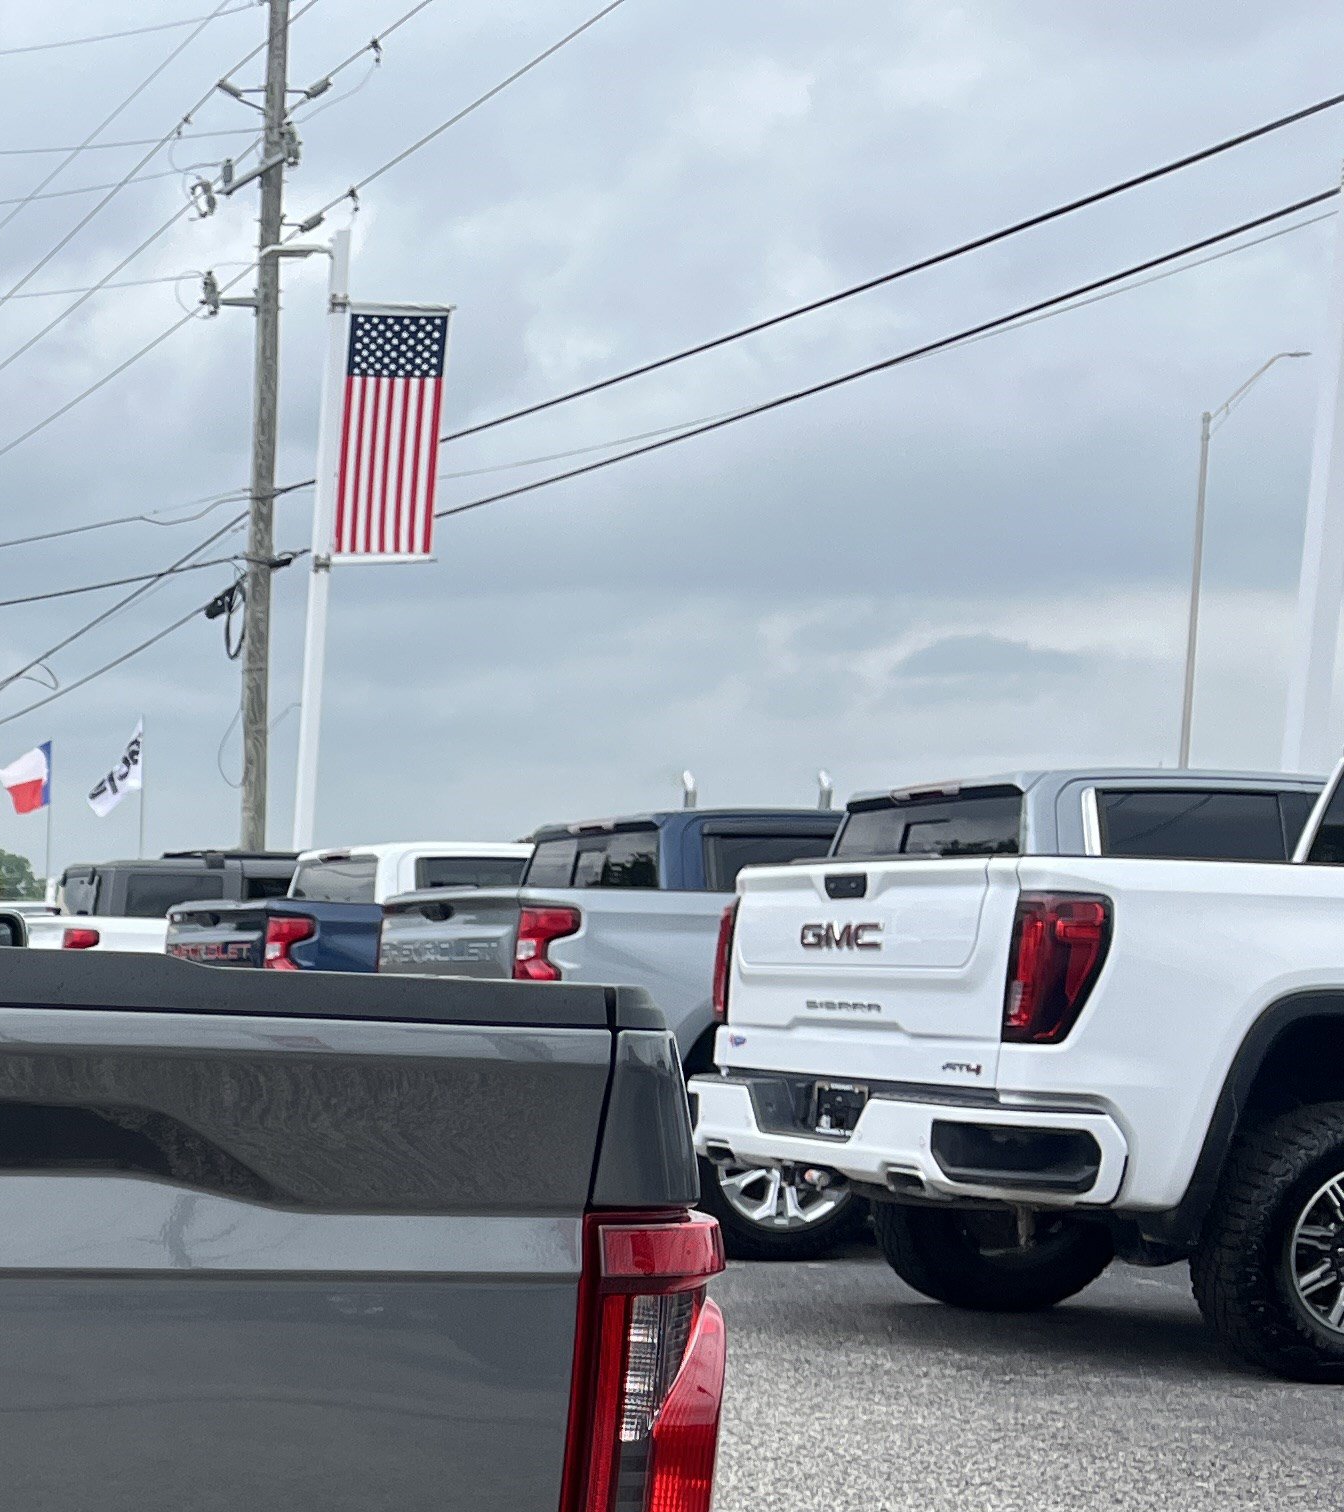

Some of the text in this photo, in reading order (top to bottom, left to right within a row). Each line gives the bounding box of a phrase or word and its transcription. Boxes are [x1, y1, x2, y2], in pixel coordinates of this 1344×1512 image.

[800, 921, 883, 950] GMC
[806, 1000, 881, 1012] SIERRA
[942, 1062, 983, 1076] AT4
